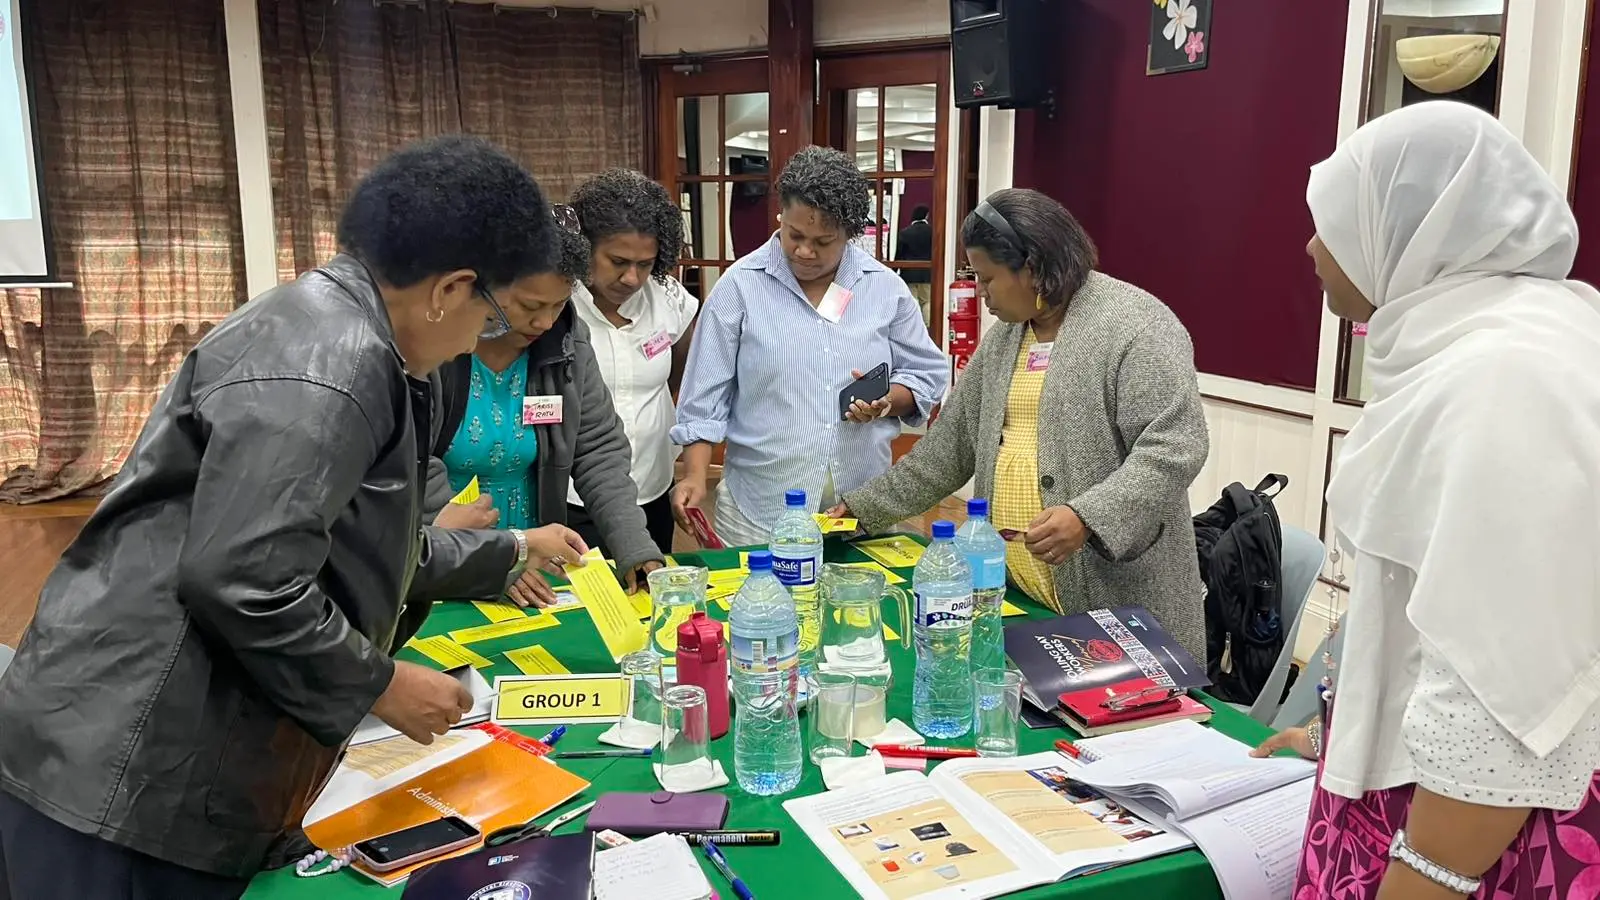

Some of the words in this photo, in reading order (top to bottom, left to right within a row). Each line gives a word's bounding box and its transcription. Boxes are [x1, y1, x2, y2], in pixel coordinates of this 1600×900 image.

[772, 560, 799, 572] uaSafe
[1034, 635, 1054, 650] DAY
[1050, 639, 1086, 676] WORKERS
[522, 693, 586, 709] GROUP
[592, 693, 601, 707] 1
[697, 834, 746, 844] Permanent
